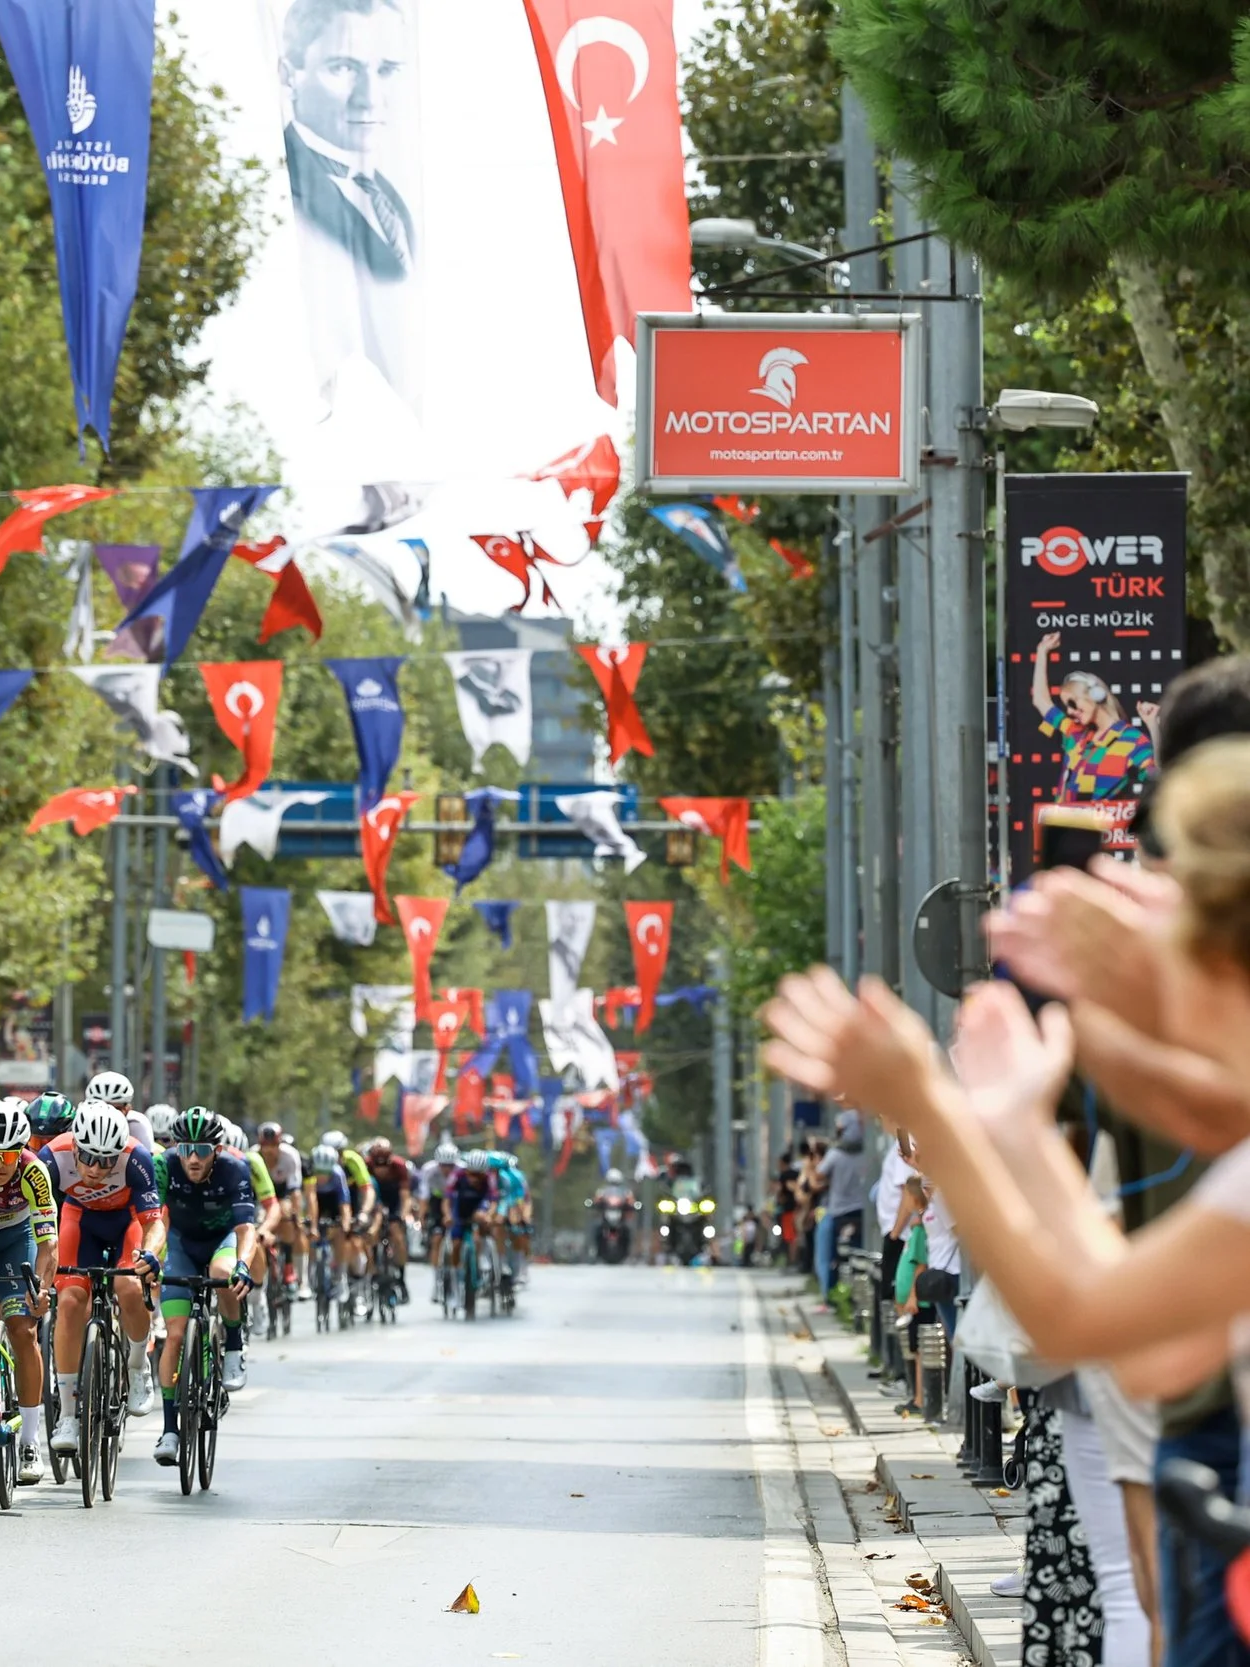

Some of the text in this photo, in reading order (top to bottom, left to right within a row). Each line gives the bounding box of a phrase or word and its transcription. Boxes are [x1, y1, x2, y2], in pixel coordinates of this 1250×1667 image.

[664, 411, 890, 435] MOTOSPARTAN
[710, 448, 843, 462] motospartan.com.tr
[1021, 535, 1163, 567] POWER
[1090, 572, 1164, 598] TÜRK
[1036, 610, 1154, 628] ÖNCE MÜZİK
[137, 1164, 152, 1186] ADRIA
